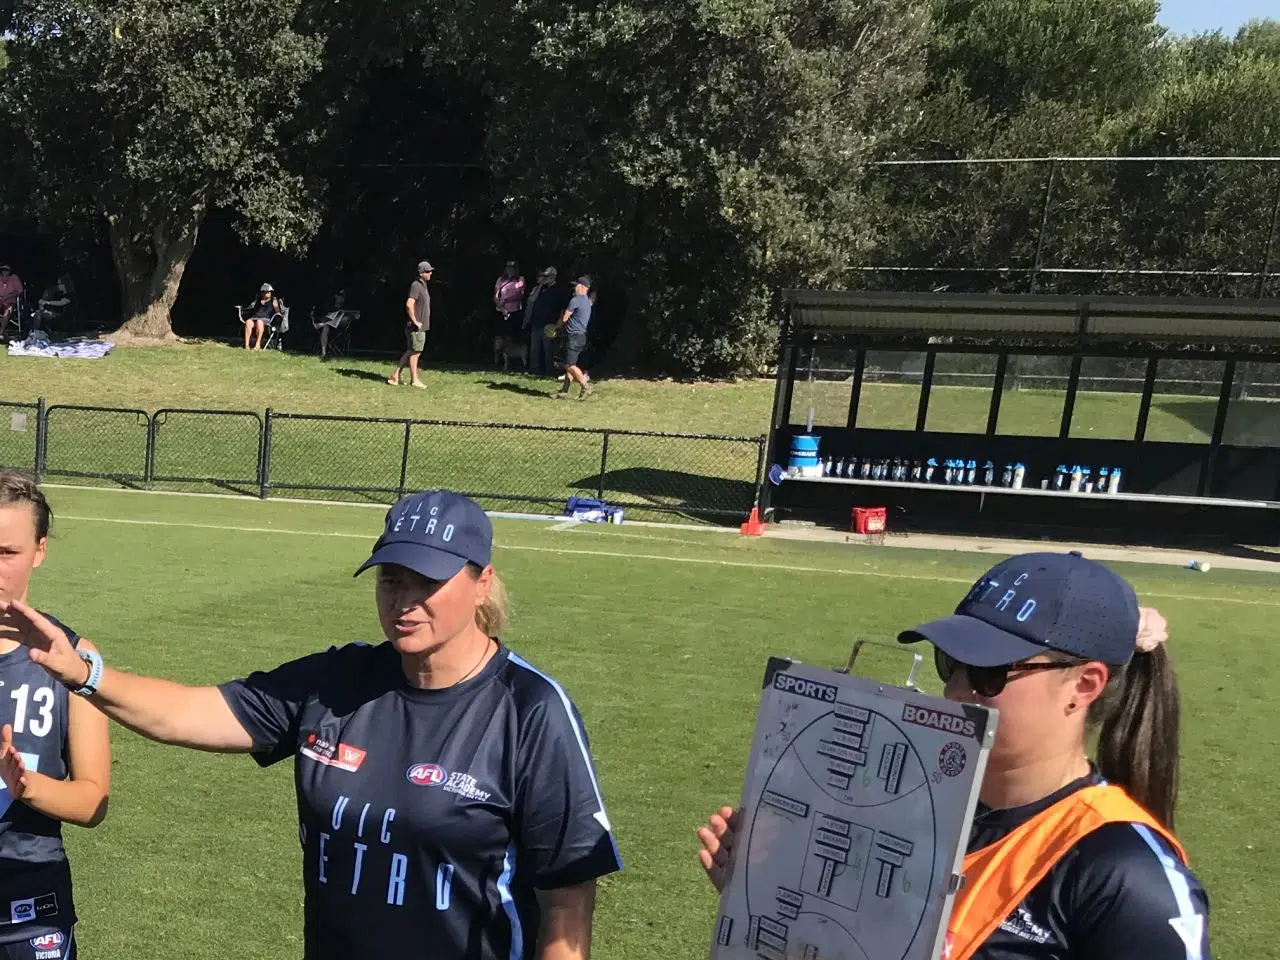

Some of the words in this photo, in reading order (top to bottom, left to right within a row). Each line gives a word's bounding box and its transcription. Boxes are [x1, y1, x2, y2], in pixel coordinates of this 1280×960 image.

[393, 516, 455, 541] ETRO
[775, 675, 837, 702] SPORTS
[10, 684, 55, 738] 13
[903, 705, 976, 735] BOARDS
[409, 767, 441, 783] AFL
[449, 771, 477, 787] STATE
[445, 780, 492, 800] ACADEMY
[319, 832, 455, 911] ETRO
[34, 933, 61, 946] AFL
[35, 949, 61, 960] VICTORIA
